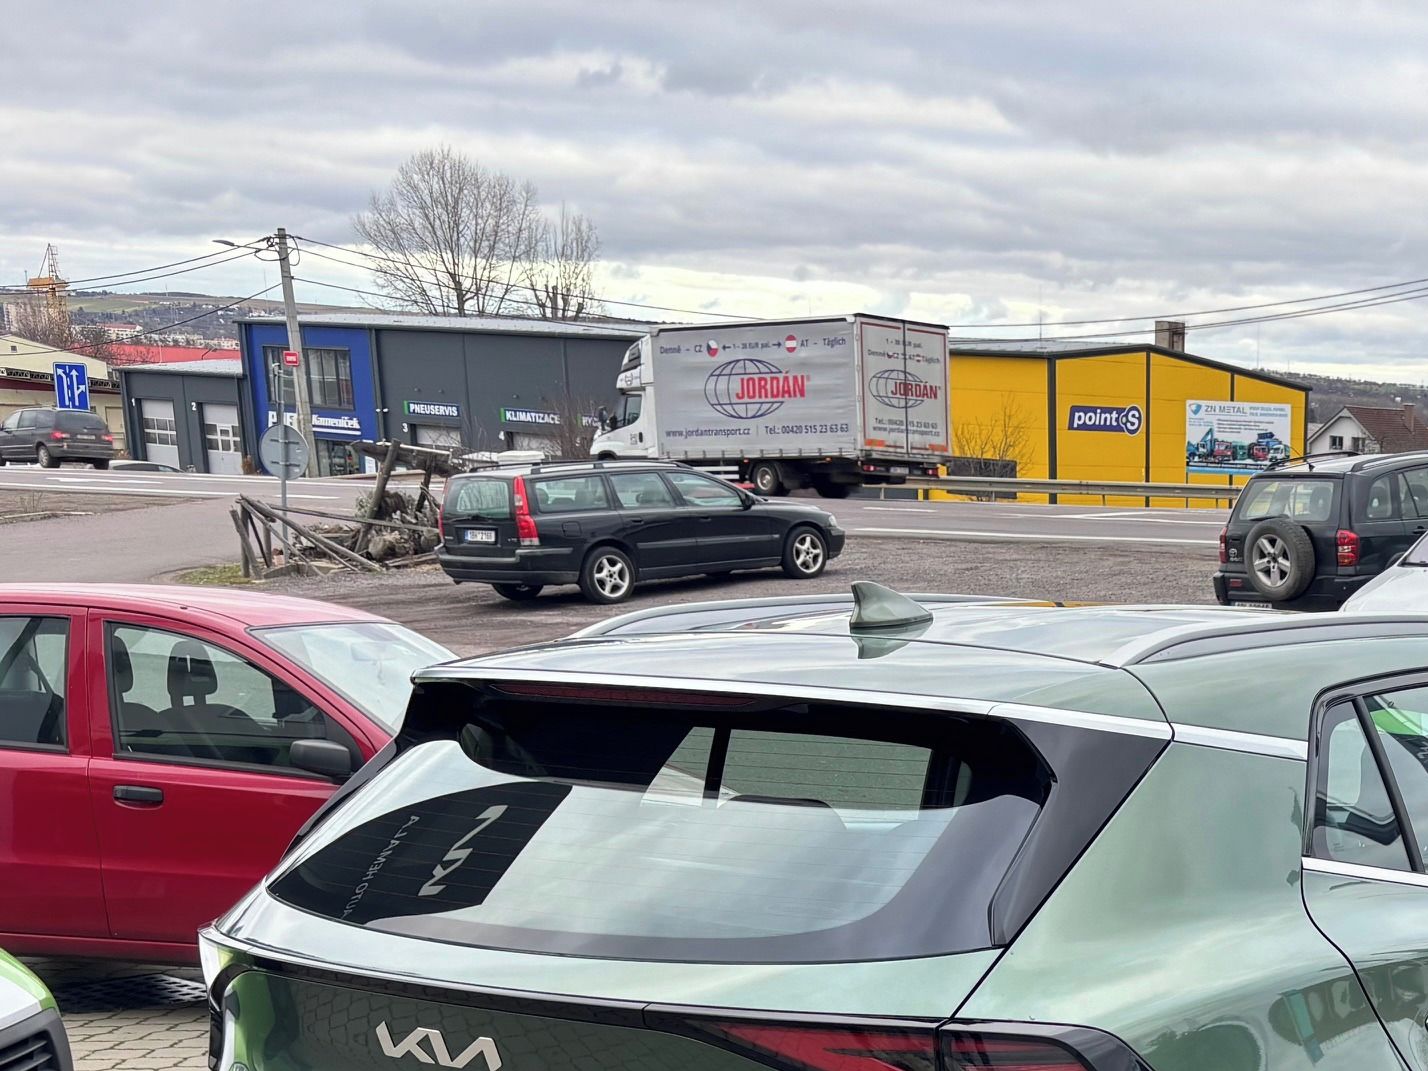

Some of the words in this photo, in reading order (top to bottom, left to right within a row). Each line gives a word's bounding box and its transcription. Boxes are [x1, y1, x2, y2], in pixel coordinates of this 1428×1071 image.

[694, 345, 703, 353] CZ
[800, 339, 809, 347] AT
[735, 369, 806, 400] JORDÁN
[890, 380, 938, 400] JORDÁN
[191, 401, 197, 411] 2
[409, 403, 458, 417] PNEUSERVIS
[505, 410, 561, 424] KLIMATIZACE
[1073, 408, 1119, 428] point
[402, 422, 409, 433] 3
[665, 427, 751, 439] www.jordantransport.cz
[781, 424, 803, 434] 00420
[804, 424, 818, 433] 515
[819, 424, 828, 433] 23
[829, 423, 839, 433] 63
[840, 423, 849, 432] 63
